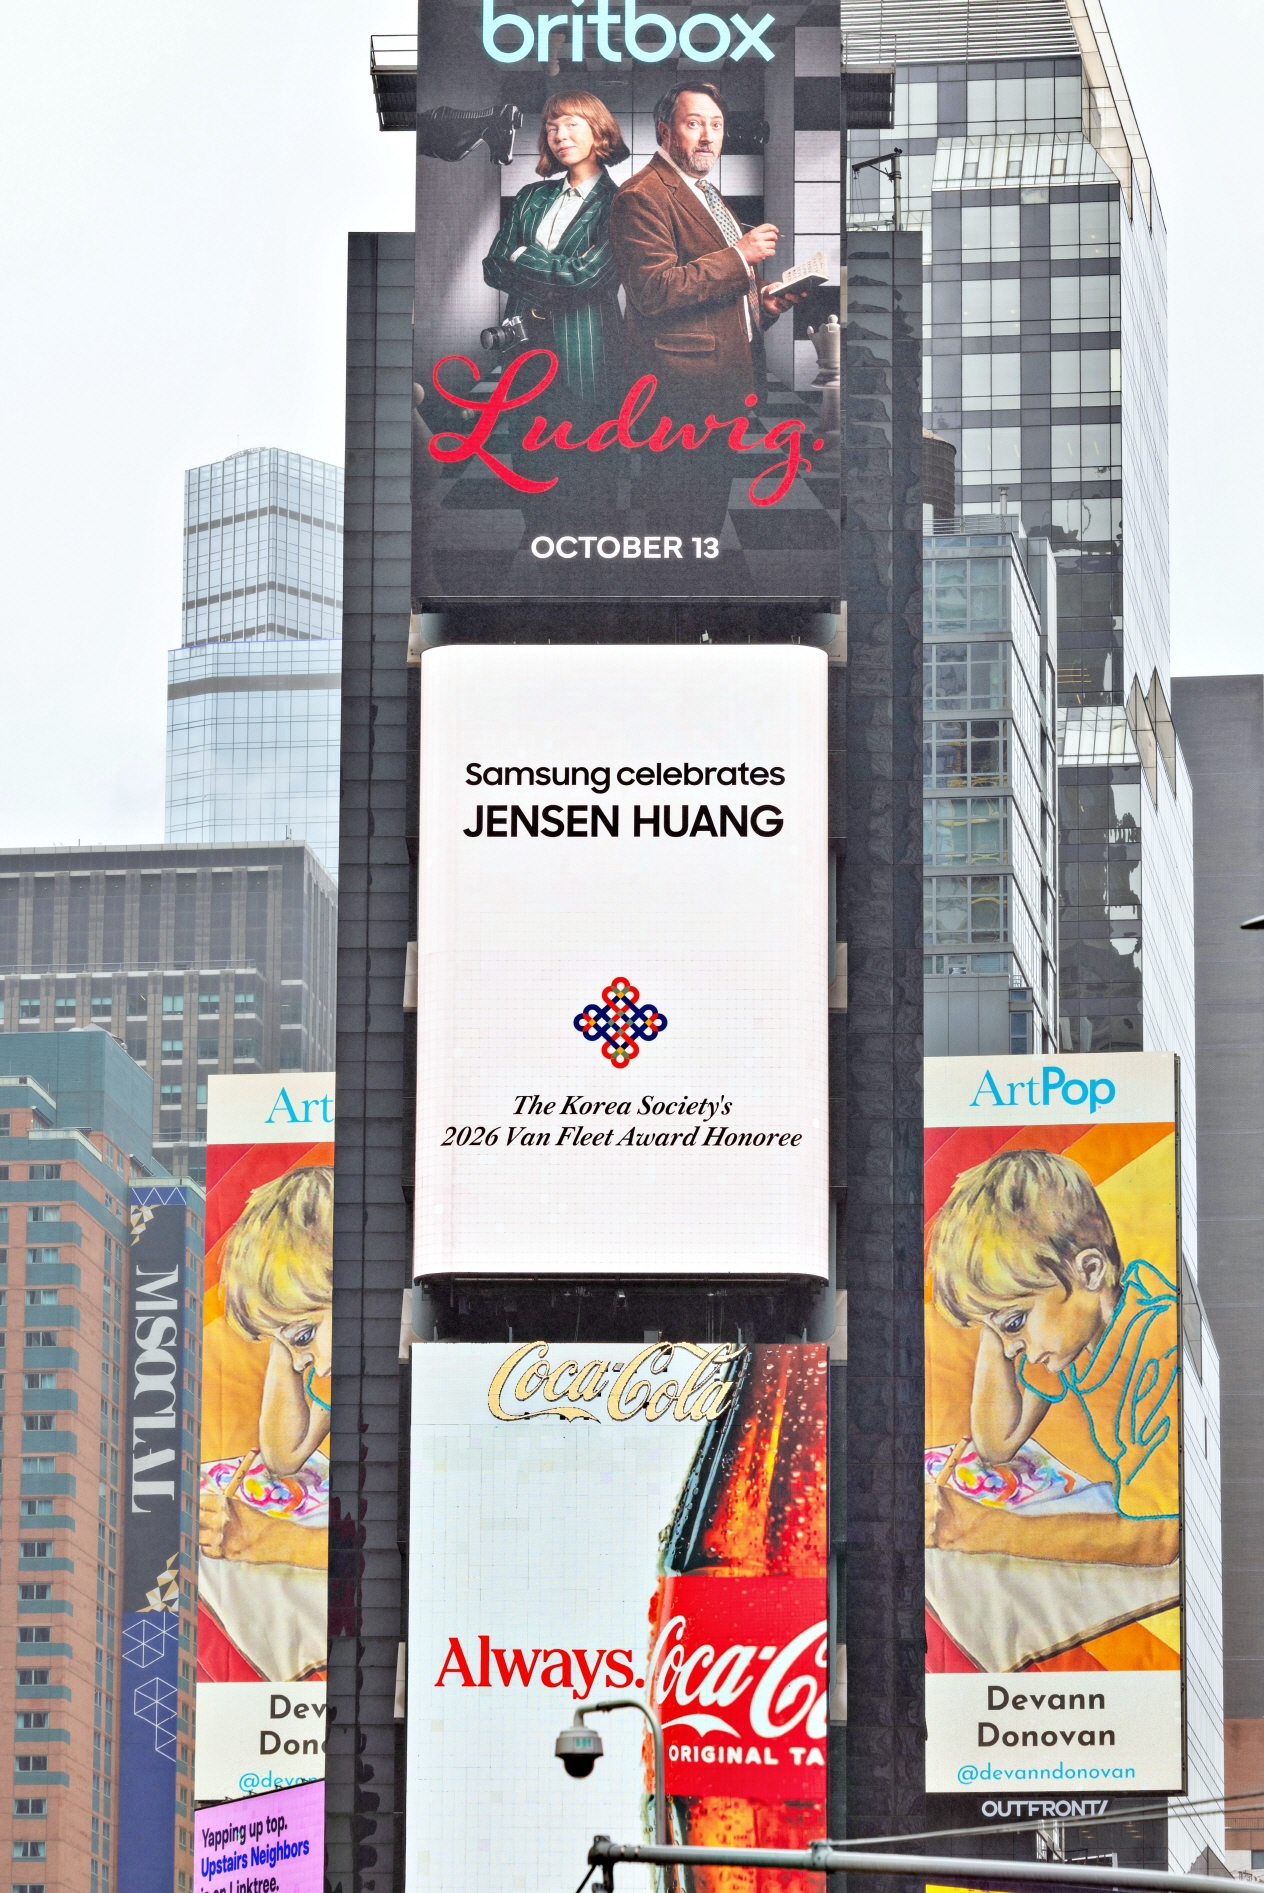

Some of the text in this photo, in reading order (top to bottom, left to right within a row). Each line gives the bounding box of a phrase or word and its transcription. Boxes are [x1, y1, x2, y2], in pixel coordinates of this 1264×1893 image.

[482, 0, 776, 63] britbox
[531, 535, 720, 559] OCTOBER 13
[465, 761, 786, 794] Samsung celebrates
[463, 804, 784, 838] JENSEN HUANG
[264, 1086, 335, 1124] Art
[969, 1065, 1116, 1115] ArtPop
[512, 1094, 733, 1123] The Korea Society's
[440, 1125, 803, 1147] 2026 Van Fleet Award Honoree
[488, 1340, 749, 1424] Coca-Cola
[434, 1634, 645, 1700] Always.
[269, 1694, 327, 1720] Dev
[987, 1685, 1106, 1711] Devann
[259, 1730, 327, 1756] Don
[977, 1721, 1116, 1748] Donovan
[668, 1744, 780, 1765] ORIGINAL
[957, 1762, 1136, 1785] @devanndonovan
[201, 1815, 288, 1852] Yapping up top.
[201, 1839, 310, 1882] Upstairs Neighbors
